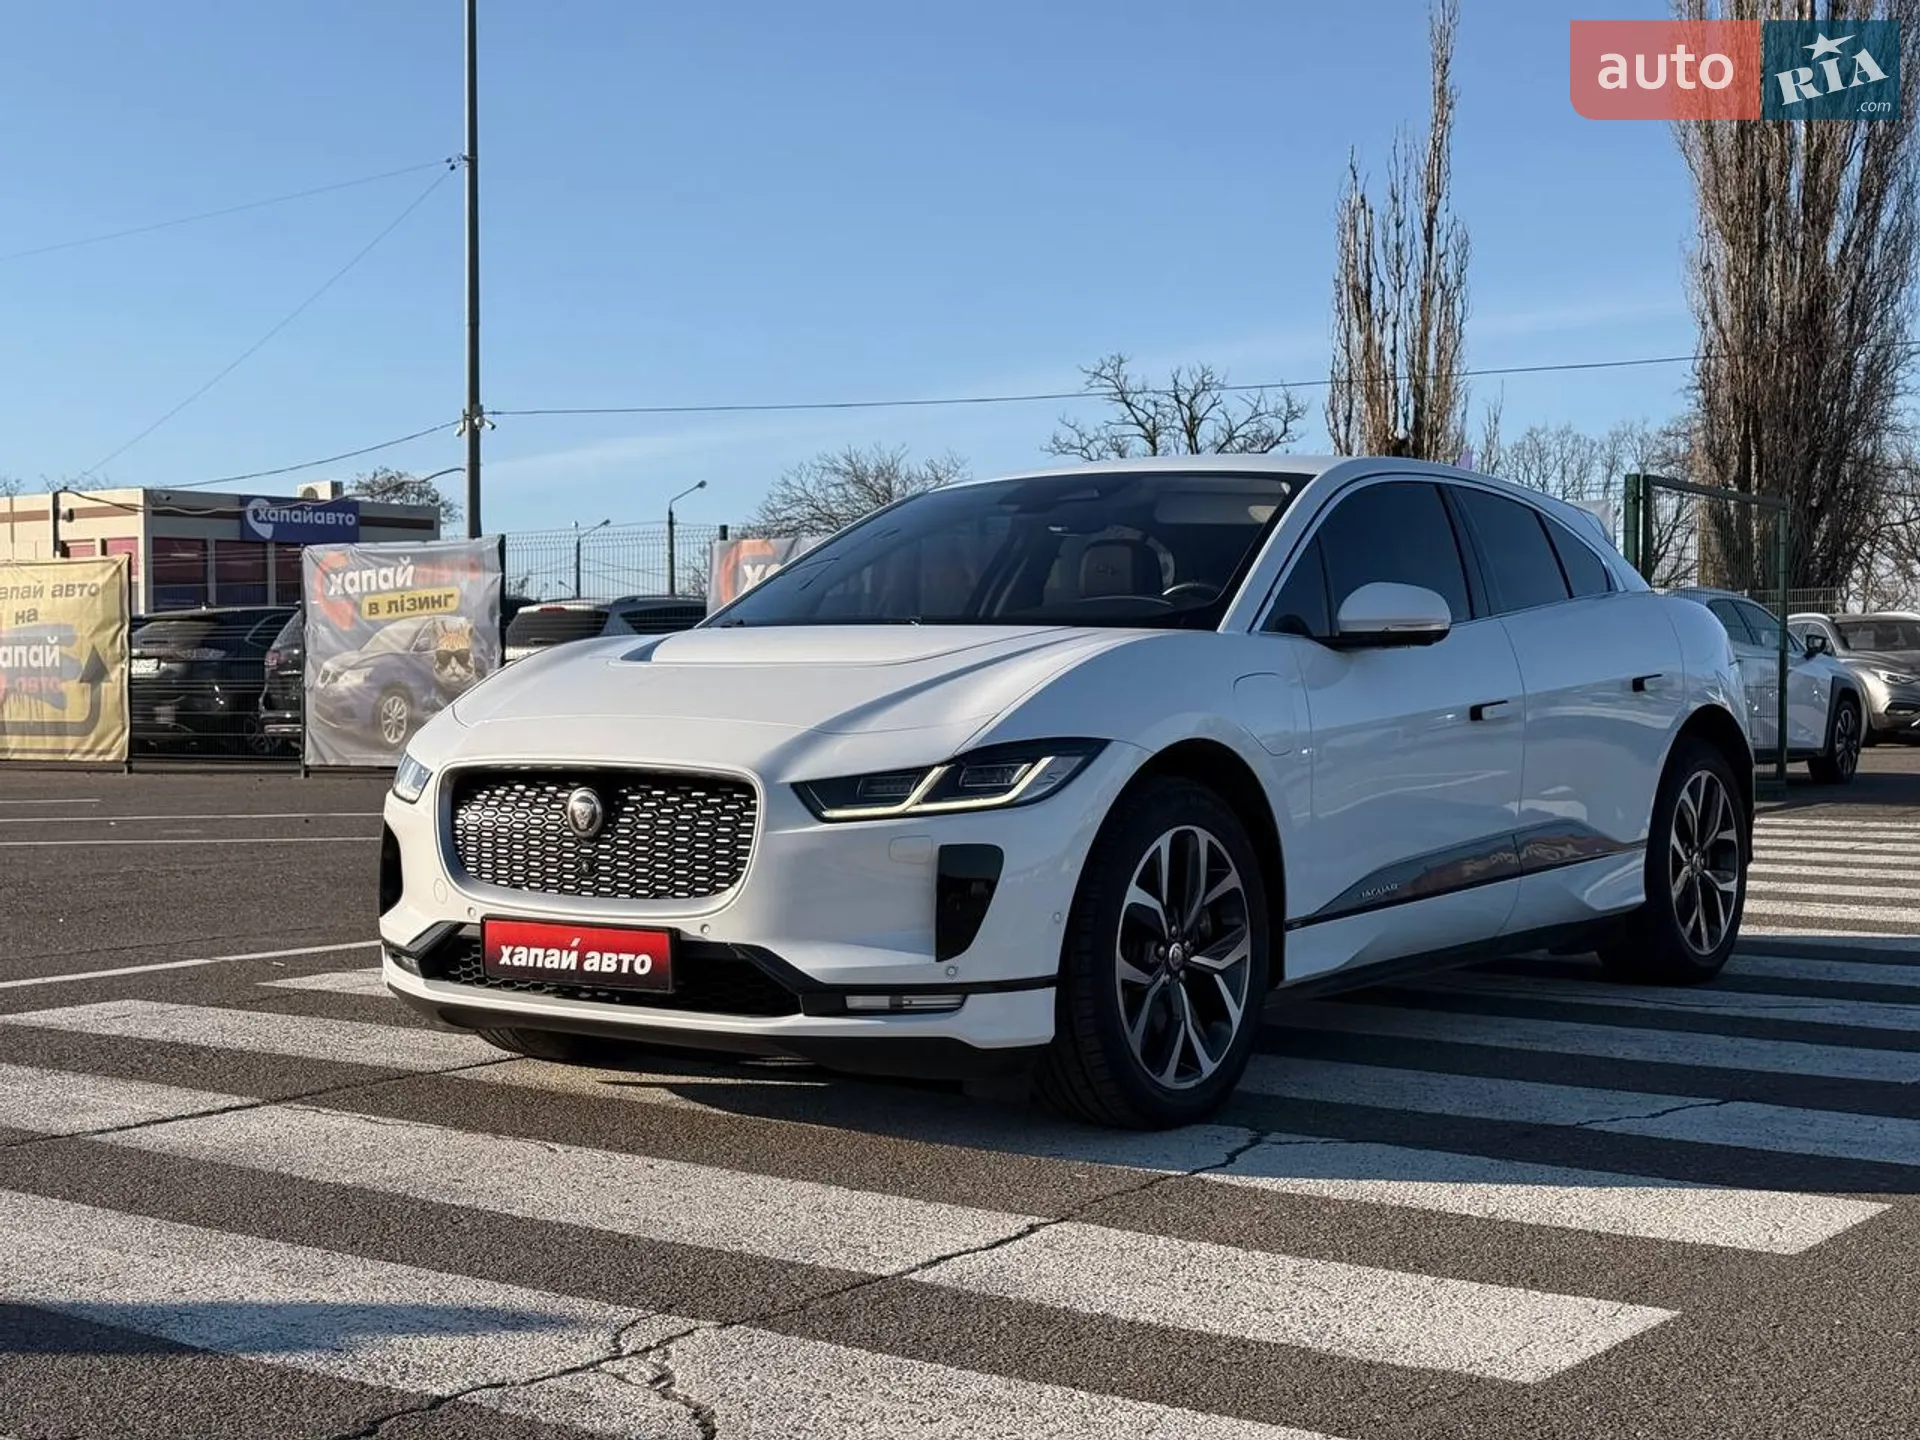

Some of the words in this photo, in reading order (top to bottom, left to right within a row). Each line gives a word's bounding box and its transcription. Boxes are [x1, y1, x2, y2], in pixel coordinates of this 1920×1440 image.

[257, 506, 356, 527] хапайавто
[328, 556, 417, 597] хапай
[51, 581, 101, 599] авто
[386, 593, 455, 615] лізинг
[15, 607, 39, 625] на
[583, 951, 653, 976] авто
